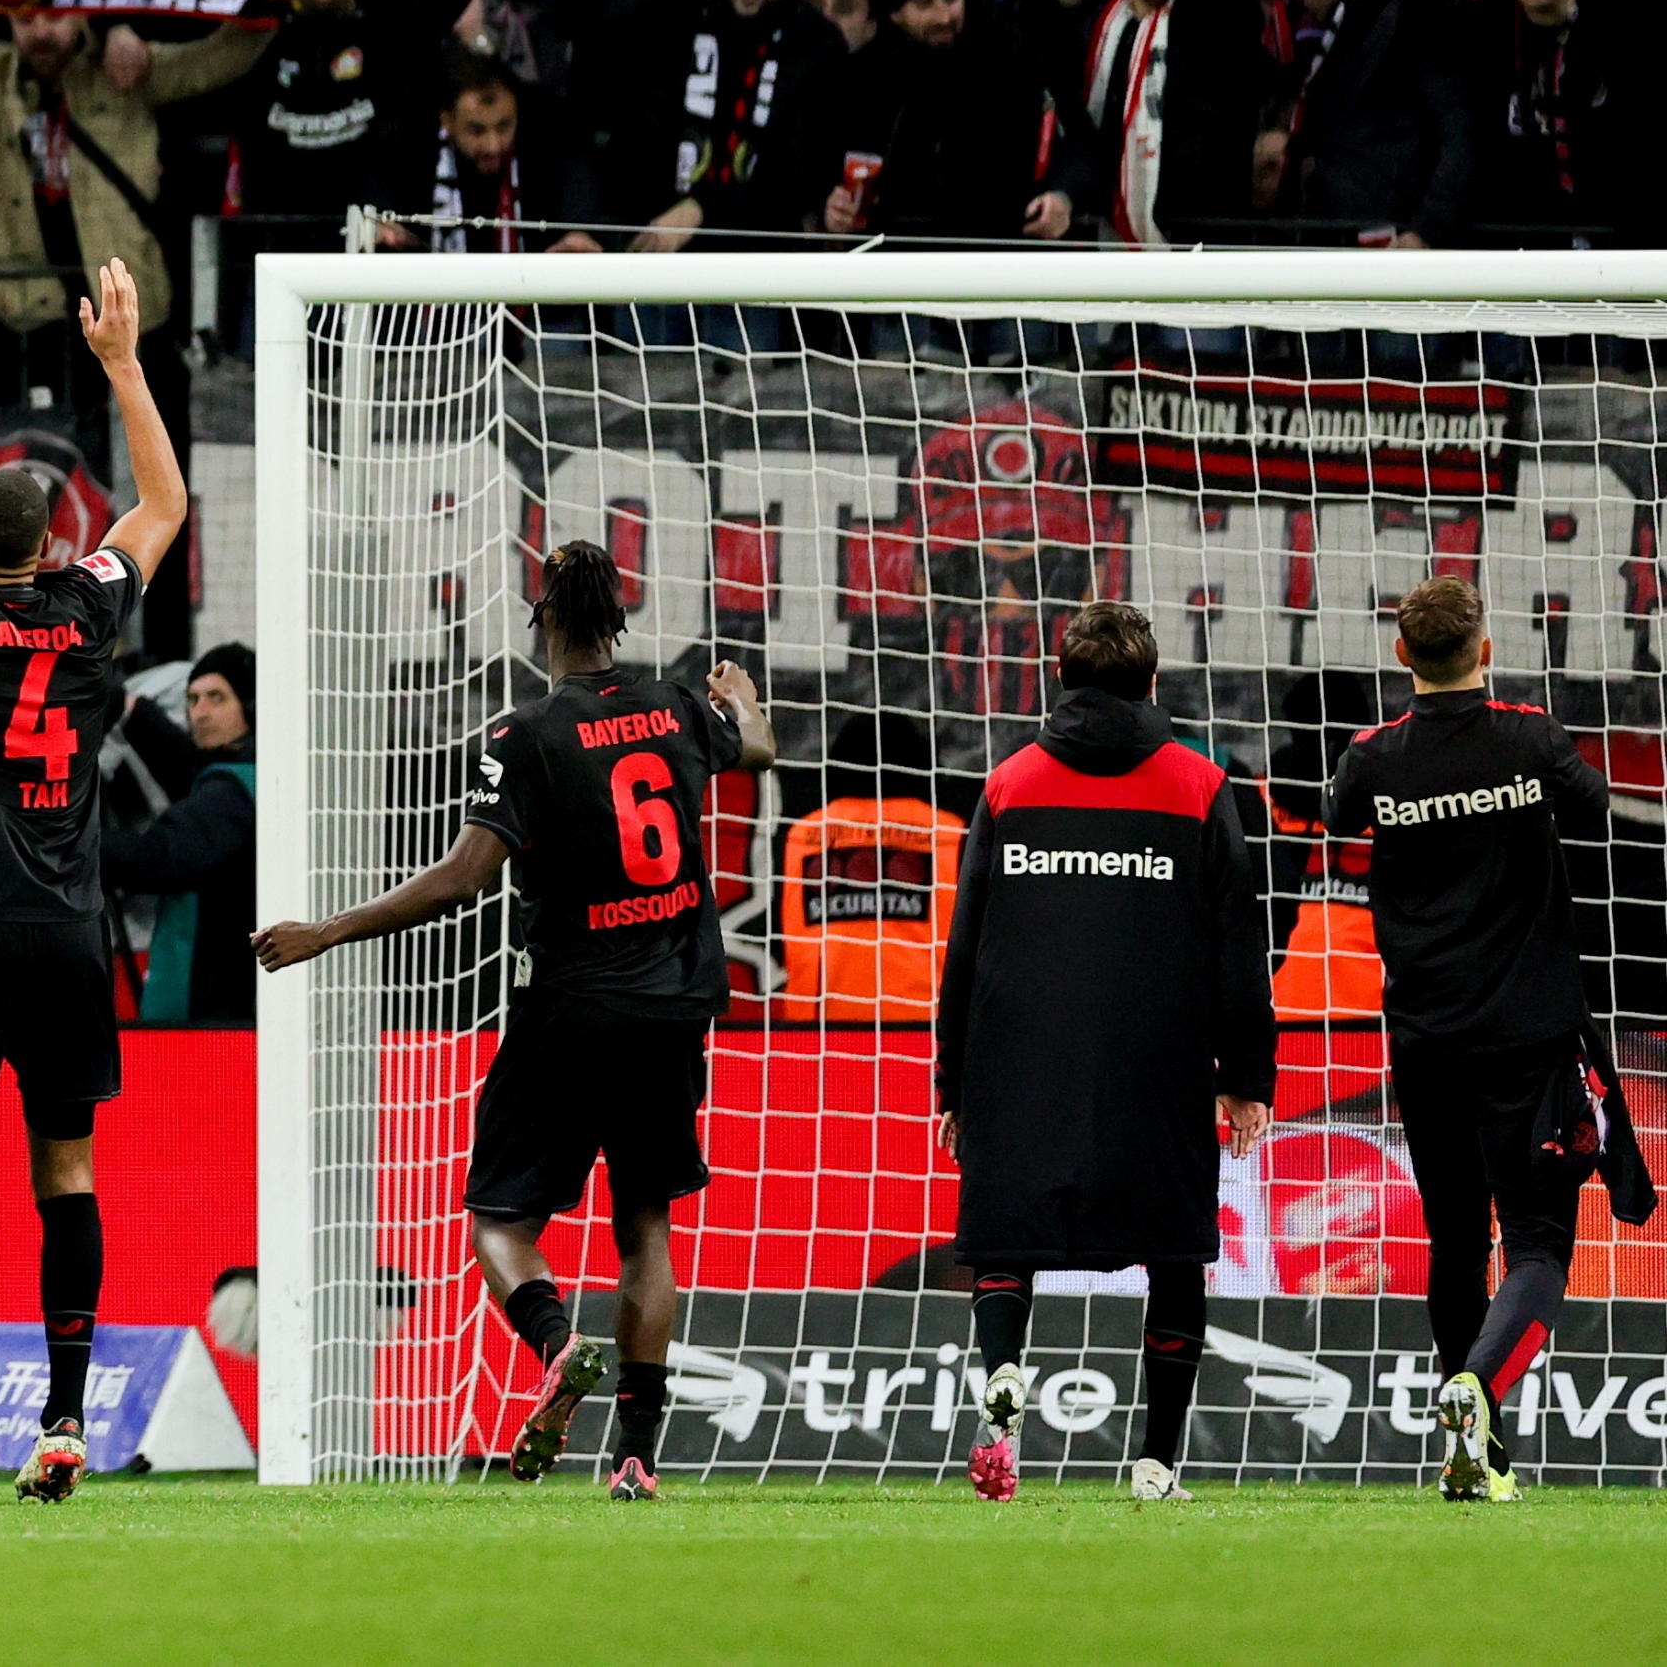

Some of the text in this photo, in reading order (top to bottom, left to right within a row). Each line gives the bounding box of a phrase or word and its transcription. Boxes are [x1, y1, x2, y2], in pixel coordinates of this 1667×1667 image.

[1110, 387, 1237, 434] SEKTION
[4, 651, 78, 782] 4
[19, 781, 68, 809] TAH
[611, 753, 681, 885] 6
[1374, 775, 1543, 826] Barmenia
[1003, 844, 1174, 881] Barmenia
